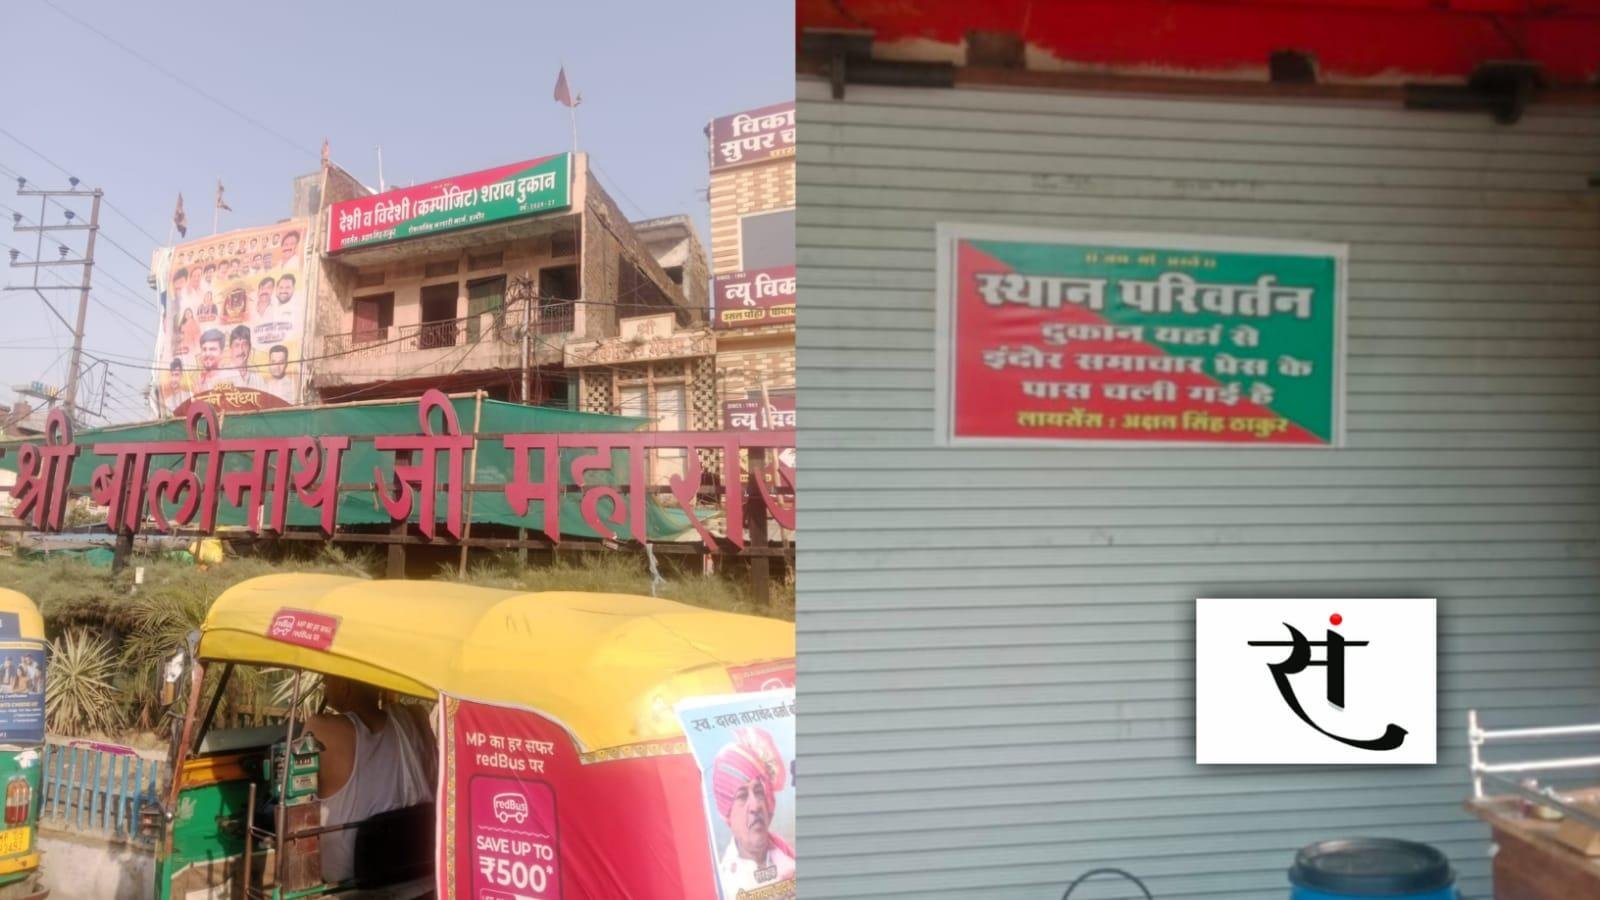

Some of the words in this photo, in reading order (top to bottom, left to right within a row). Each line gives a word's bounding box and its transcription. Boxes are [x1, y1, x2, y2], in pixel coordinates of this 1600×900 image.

[720, 132, 776, 162] सुपर
[339, 208, 361, 232] देशी
[363, 211, 372, 226] व
[374, 197, 410, 226] विदेशी
[517, 171, 556, 203] दुकान
[725, 282, 756, 306] न्यू
[975, 273, 1107, 309] स्थान
[1118, 272, 1315, 318] परिवर्तन
[1041, 323, 1143, 345] दुकान
[1230, 324, 1260, 347] से
[1077, 353, 1204, 373] समाचार
[1277, 354, 1314, 376] के
[224, 388, 263, 408] संध्या
[1021, 381, 1091, 399] पास
[1103, 380, 1177, 401] चली
[1187, 381, 1242, 406] गई
[1122, 413, 1178, 431] अक्षत
[1182, 410, 1226, 433] सिंह
[1229, 417, 1289, 438] ठाकुर
[11, 407, 80, 531] श्री
[92, 401, 349, 537] बालीनाथ
[374, 389, 473, 541] जी
[466, 732, 487, 746] MP
[490, 735, 504, 749] का
[508, 737, 522, 753] हर
[525, 739, 555, 755] सफर
[476, 753, 525, 771] redBus
[528, 757, 544, 773] पर
[495, 798, 527, 812] redBus
[476, 835, 509, 855] SAVE
[511, 841, 531, 857] UP
[533, 844, 553, 861] TO
